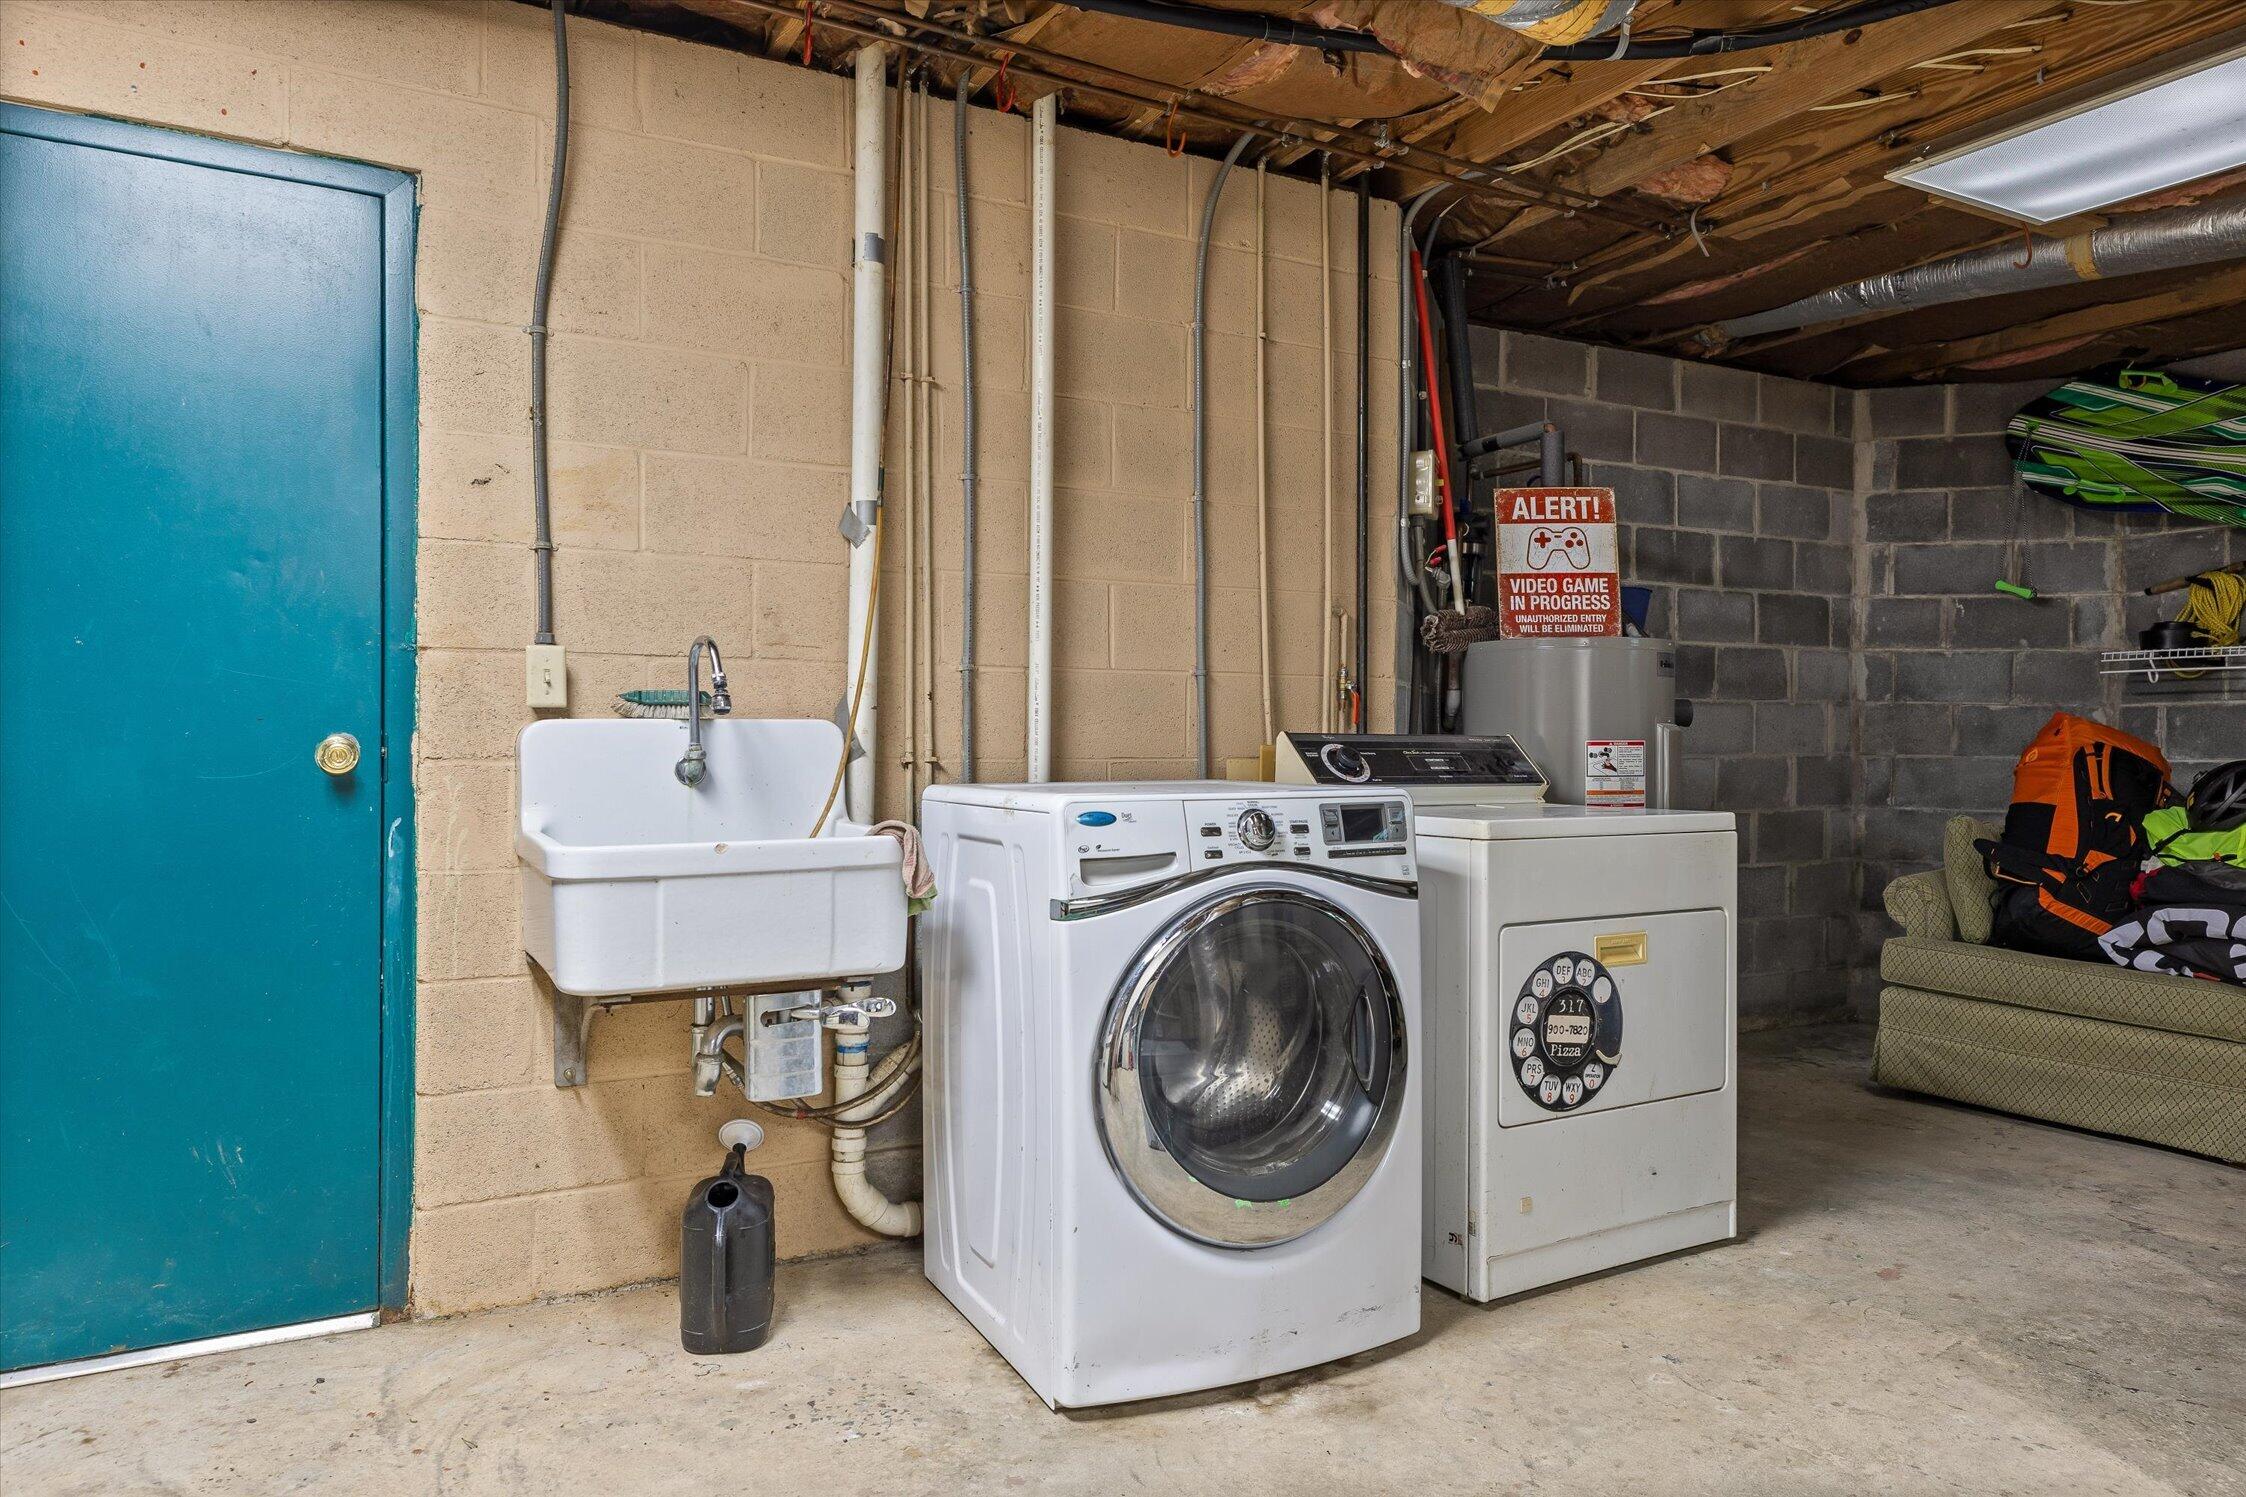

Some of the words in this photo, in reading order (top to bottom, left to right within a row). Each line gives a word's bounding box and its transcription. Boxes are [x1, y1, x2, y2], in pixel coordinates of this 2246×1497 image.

[1512, 496, 1599, 520] ALERT!
[1510, 578, 1558, 593] VIDEO
[1563, 578, 1608, 593] GAME
[1510, 596, 1525, 610] IN
[1531, 595, 1610, 610] PROGRESS
[1516, 614, 1578, 622] UNAUTHORIZED
[1555, 624, 1603, 632] ELIMINATED
[1556, 966, 1571, 975] DEF
[1577, 968, 1592, 978] ABC
[1536, 978, 1550, 988] GHI
[1521, 1003, 1536, 1014] JKL
[1559, 999, 1584, 1012] 317
[1526, 1013, 1532, 1022] 5
[1548, 1024, 1588, 1035] 900-7820
[1517, 1037, 1534, 1047] MNO
[1521, 1047, 1527, 1056] 6
[1550, 1044, 1581, 1056] Pizza
[1527, 1064, 1542, 1074] PRS
[1530, 1074, 1535, 1084] 7
[1545, 1081, 1559, 1091] TUV
[1566, 1083, 1581, 1092] WXY
[1546, 1092, 1552, 1101] 8
[1569, 1094, 1575, 1103] 9
